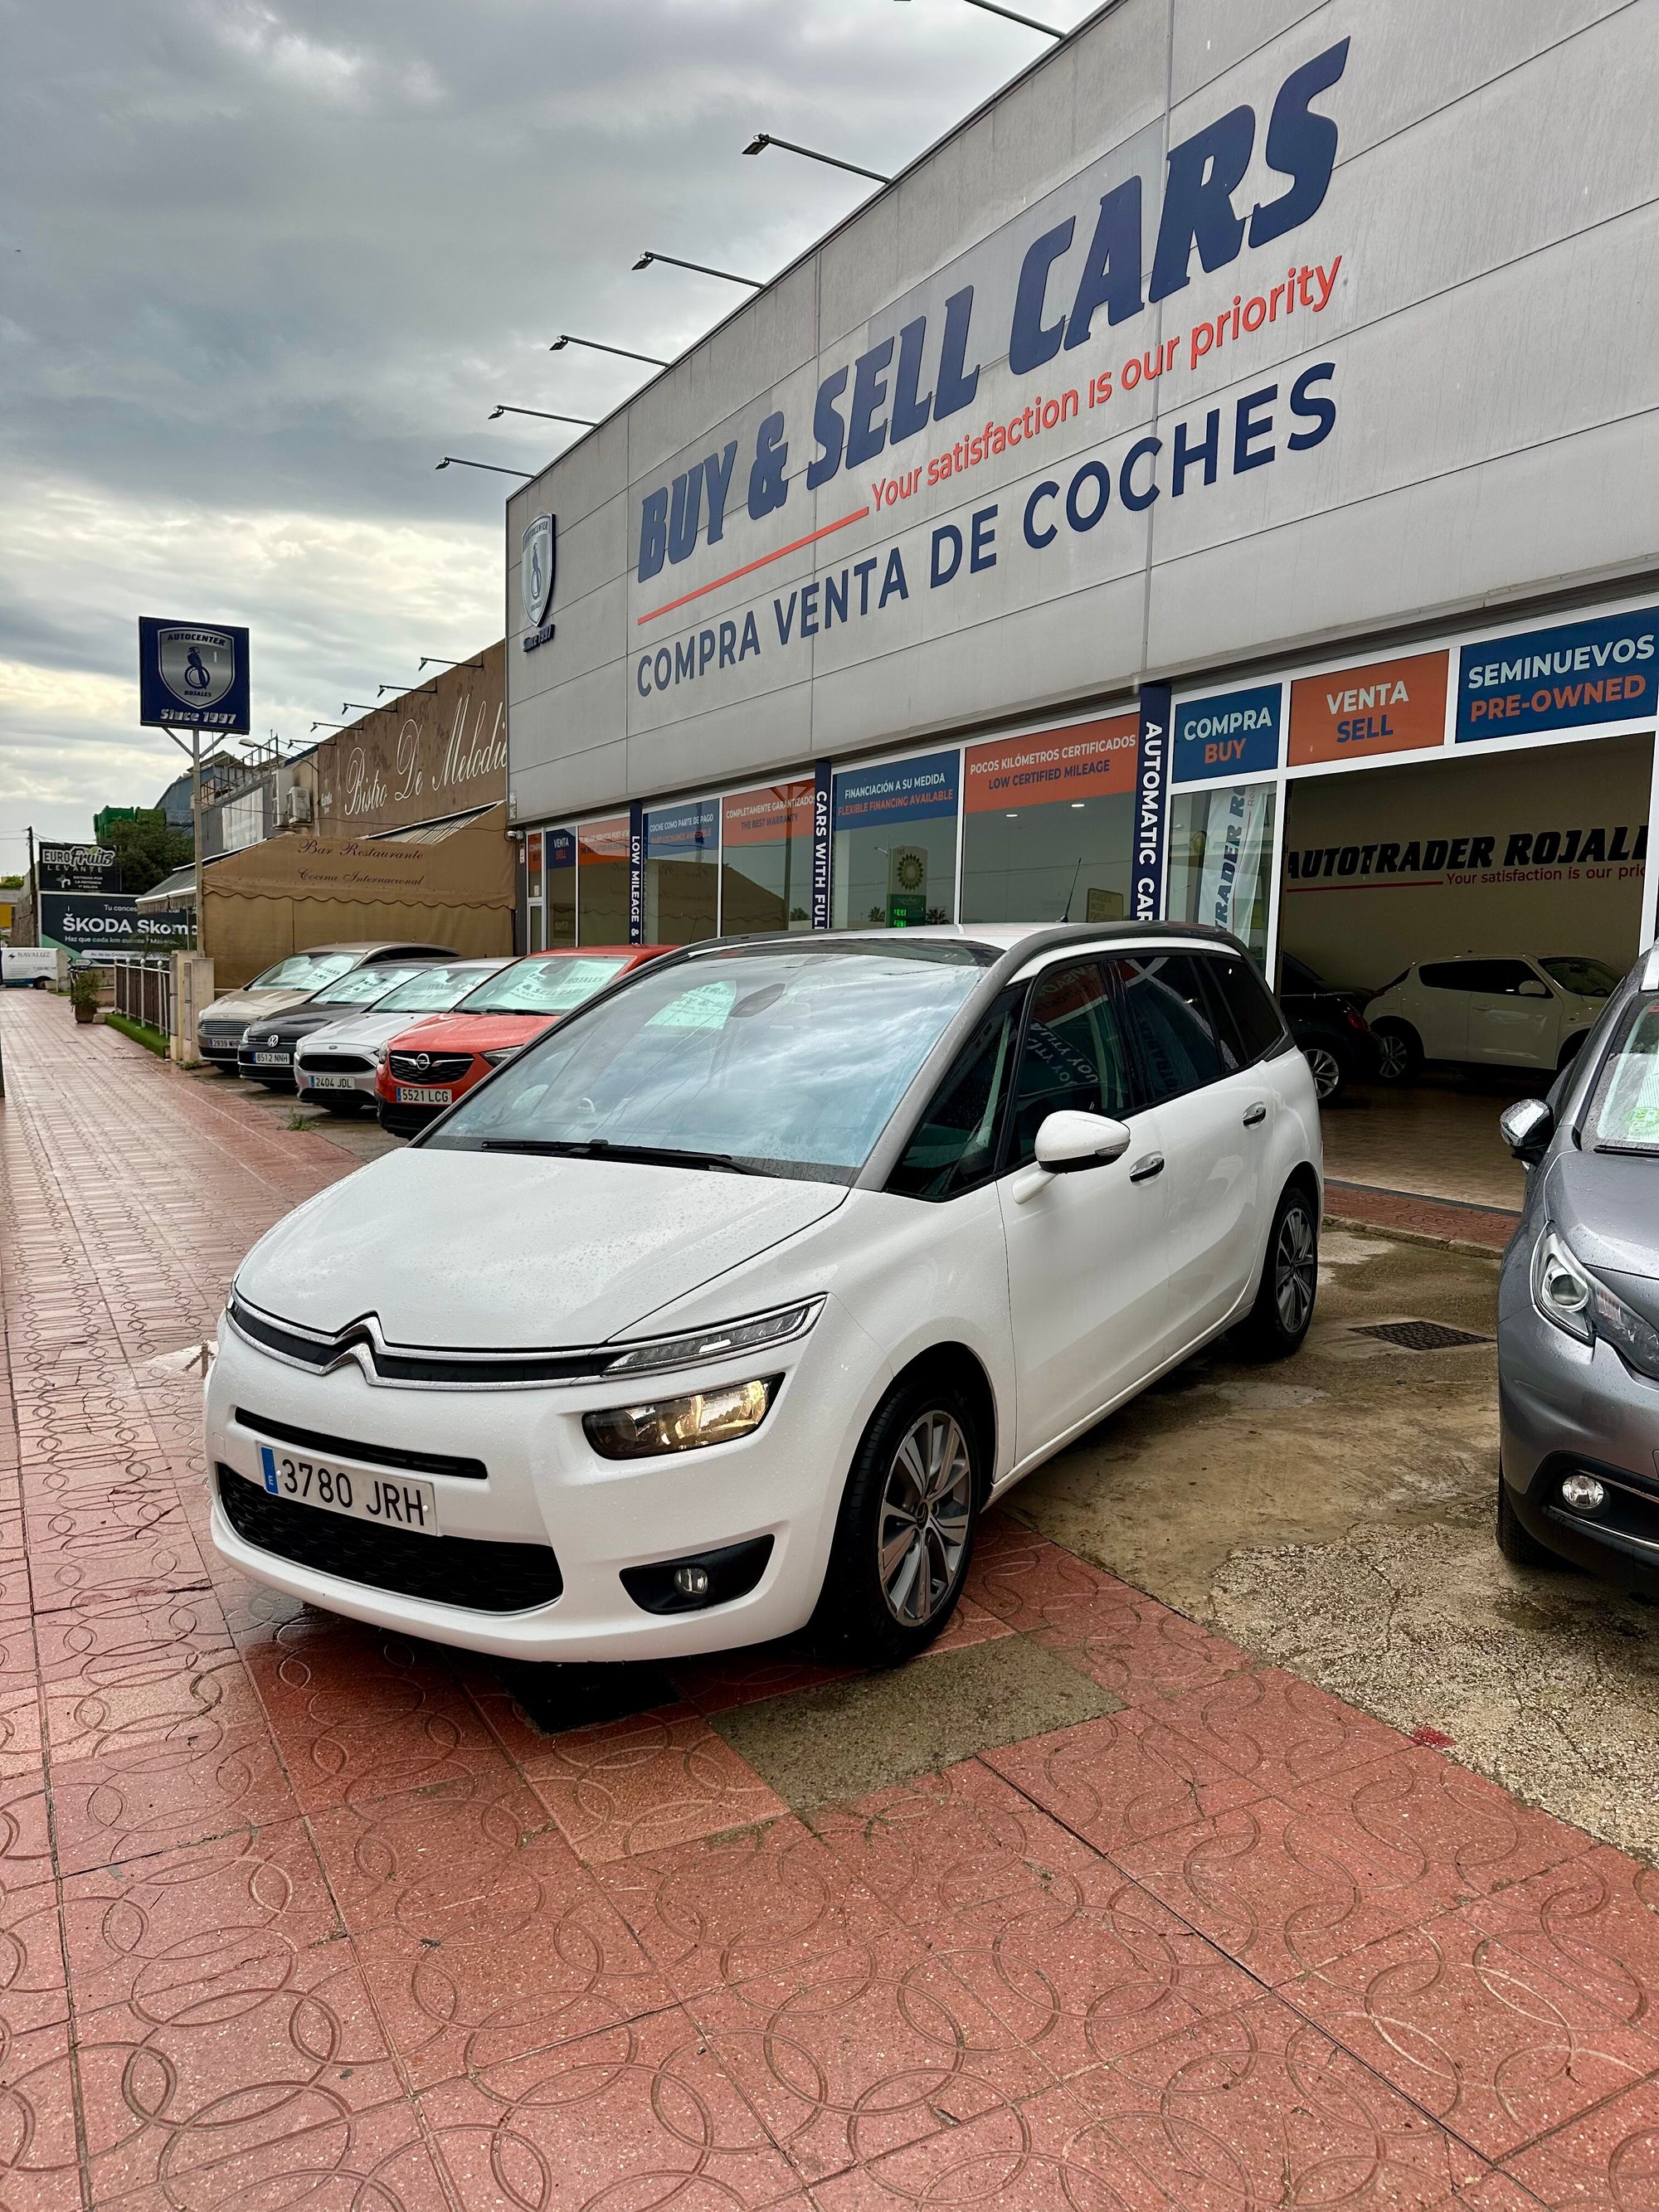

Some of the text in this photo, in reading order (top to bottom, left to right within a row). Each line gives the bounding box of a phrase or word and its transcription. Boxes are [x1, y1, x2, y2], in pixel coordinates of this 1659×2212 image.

[637, 36, 1351, 584] BUY & SELL CARS
[872, 466, 922, 512] Your
[927, 385, 1079, 488] satisfaction
[1121, 338, 1180, 391] our
[1190, 255, 1342, 370] priority
[637, 362, 1336, 697] COMPRA VENTA DE COCHES
[168, 633, 226, 646] AUTOCENTER
[1467, 634, 1656, 690] SEMINUEVOS
[1326, 679, 1409, 715] VENTA
[1471, 673, 1647, 723] PRE-OWNED
[203, 712, 236, 724] 1997
[1183, 706, 1272, 741] COMPRA
[1336, 714, 1394, 743] SELL
[970, 734, 1136, 775] POCOS KILÓMETROS CERTIFICADOS
[1204, 738, 1247, 765] BUY
[344, 746, 387, 815] Bistro
[394, 718, 423, 801] De
[989, 760, 1111, 790] LOW CERTIFIED MILEAGE
[844, 772, 946, 800] FINANCIACIÓN A SU MEDIDA
[1139, 721, 1163, 865] AUTOMATIC
[726, 801, 771, 819] COMPLETAMENTE
[815, 790, 828, 838] CARS
[838, 789, 953, 816] FLEXIBLE FINANCING AVAILABLE
[649, 813, 714, 833] COCHE COMO PARTE DE PAGO
[741, 814, 798, 830] THE BEST WARRANTY
[298, 839, 424, 860] Bar Restaurante
[553, 837, 570, 848] VENTA
[556, 849, 567, 859] SELL
[631, 836, 640, 864] LOW
[47, 864, 103, 873] LEVANTE
[815, 843, 827, 888] WITH
[1287, 835, 1496, 880] AUTOTRADER
[298, 868, 425, 886] Cocina Internacional
[1447, 872, 1477, 887] Your
[1481, 867, 1562, 884] satisfaction
[1568, 866, 1580, 879] is
[1586, 867, 1613, 879] our
[631, 871, 640, 922] MILEAGE
[63, 913, 133, 934] ŠKODA
[631, 928, 640, 936] &
[315, 1077, 352, 1088] 2404 JDL
[402, 1088, 449, 1104] 5521 LCG
[281, 1458, 425, 1526] 3780 JRH
